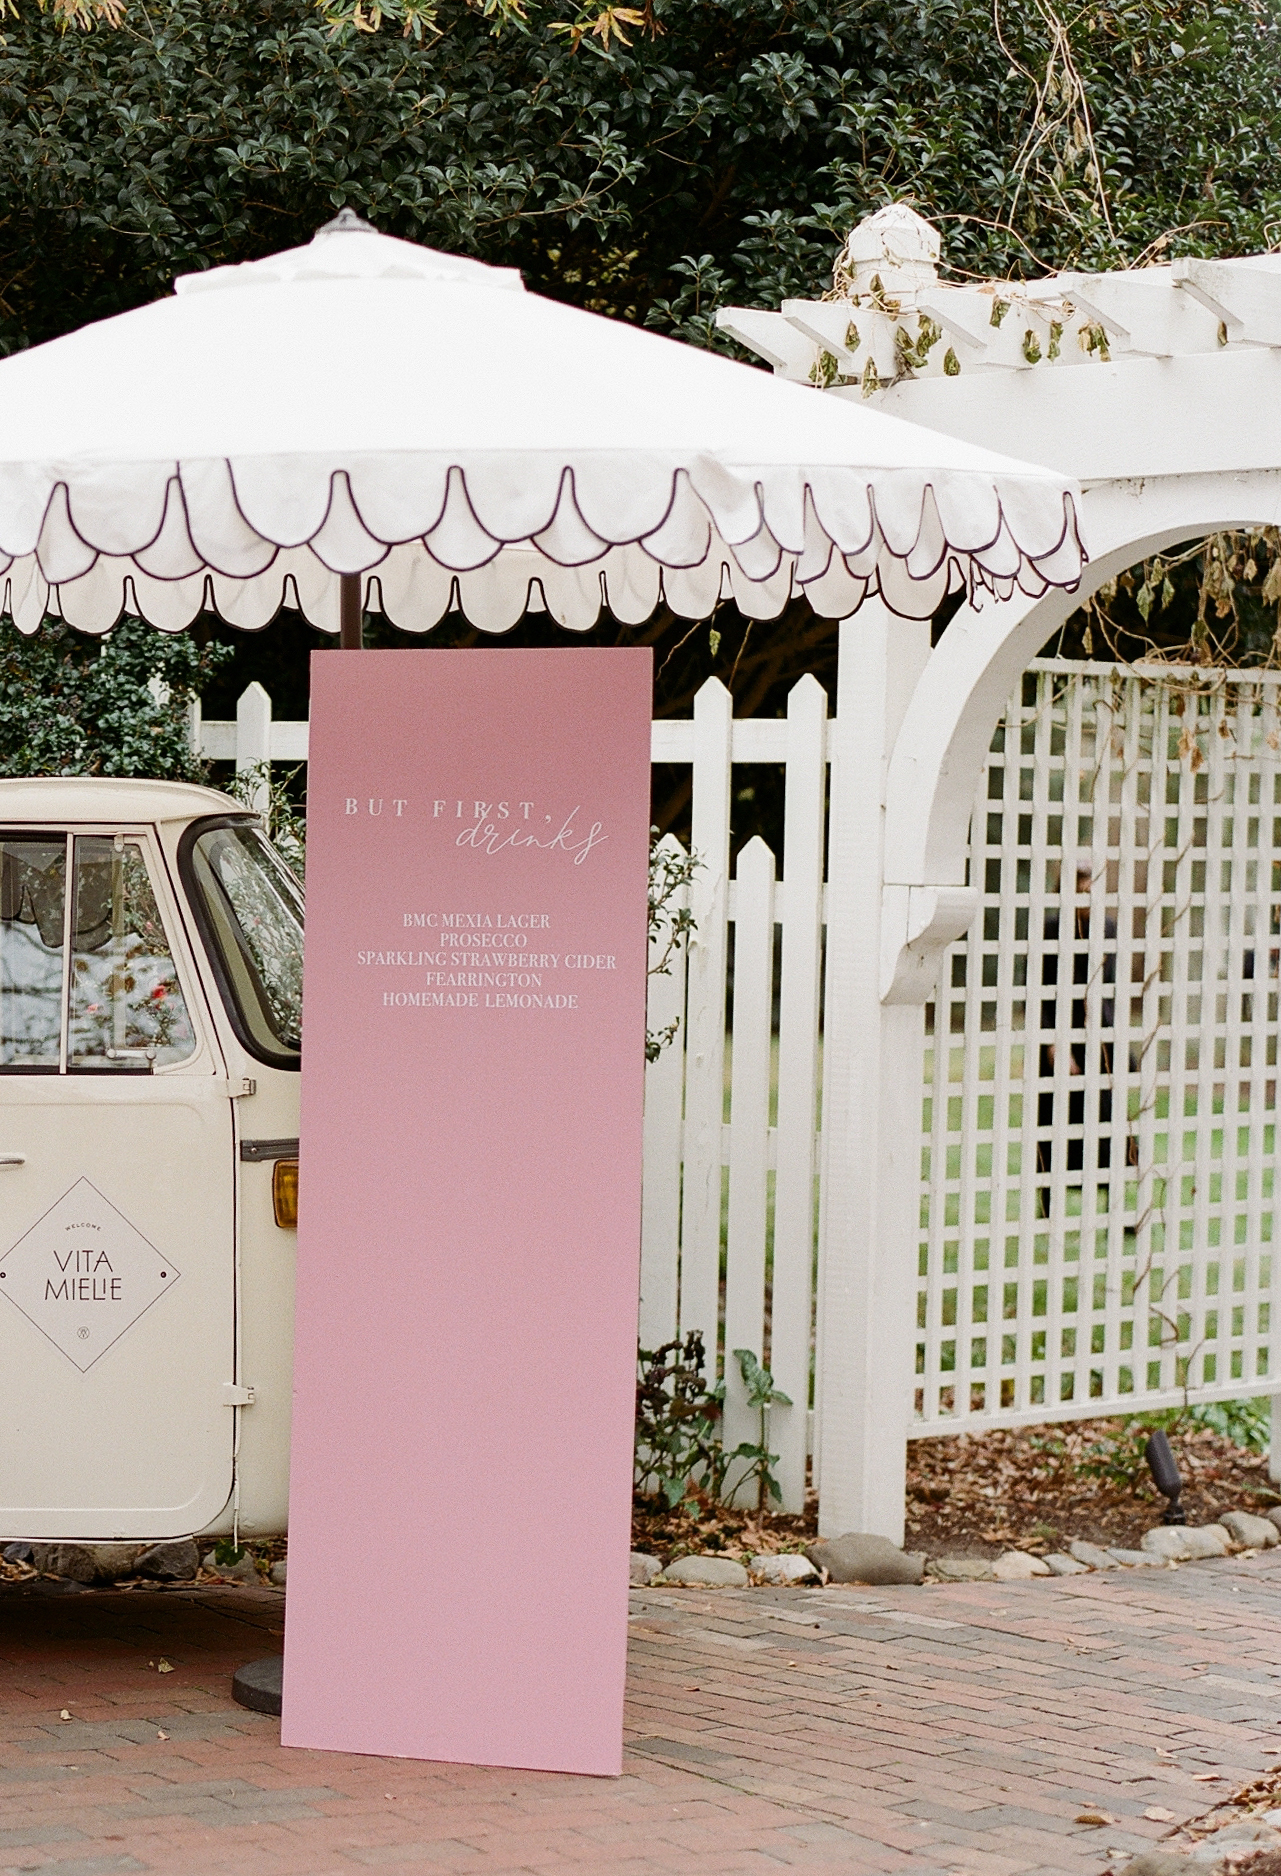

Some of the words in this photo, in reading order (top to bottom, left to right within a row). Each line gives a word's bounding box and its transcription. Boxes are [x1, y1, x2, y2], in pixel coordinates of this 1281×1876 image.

[344, 797, 409, 817] BUT
[432, 800, 553, 824] FIRST,
[455, 803, 610, 866] drinks
[402, 913, 439, 928] BMC
[441, 914, 493, 928] MEXIA
[496, 914, 551, 929] LAGER
[439, 933, 528, 948] PROSECCO
[357, 951, 447, 967] SPARKLING
[450, 952, 562, 968] STRAWBERRY
[564, 954, 617, 970] CIDER
[425, 972, 543, 988] FEARRINGTON
[382, 992, 479, 1008] HOMEMADE
[484, 994, 579, 1009] LEMONADE
[64, 1222, 102, 1232] WELCOME
[53, 1250, 114, 1273] VITA
